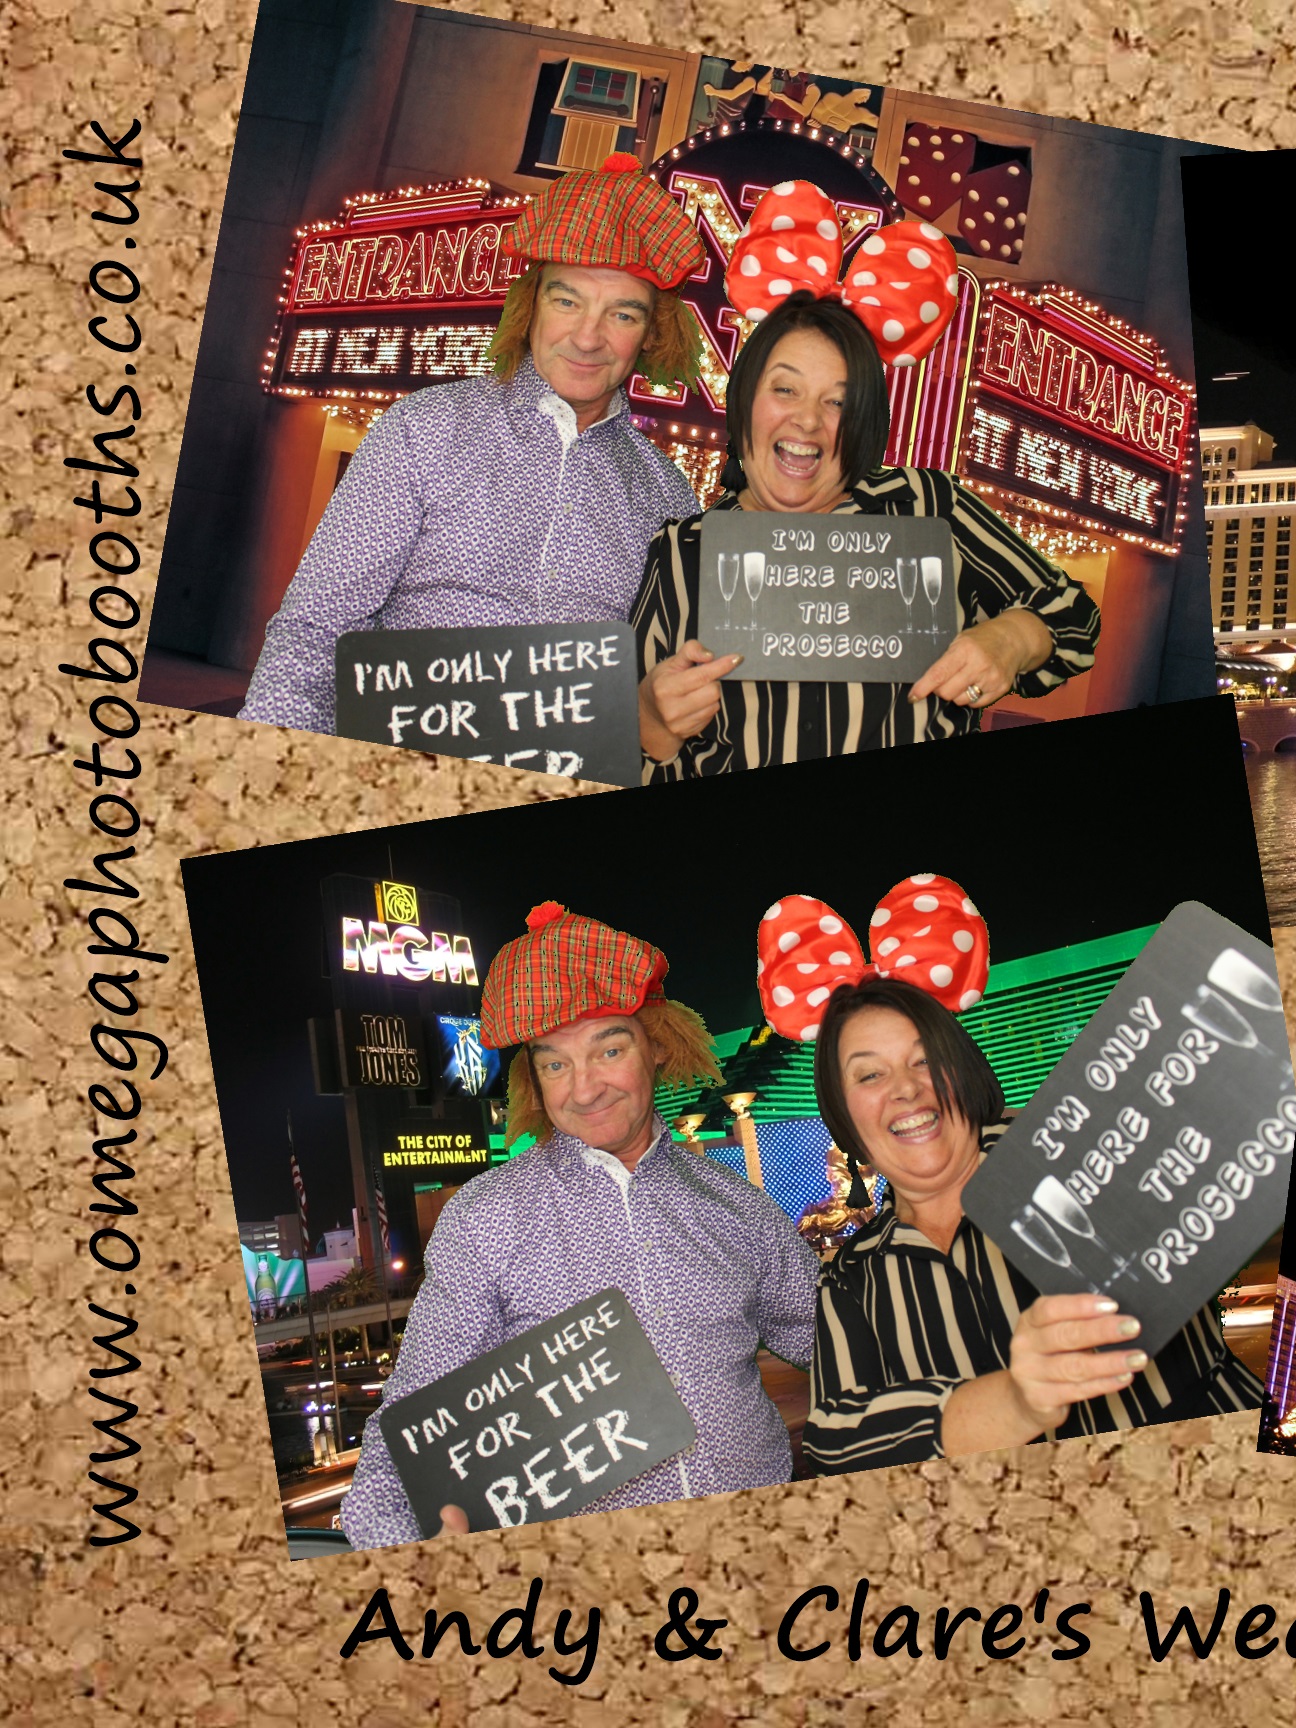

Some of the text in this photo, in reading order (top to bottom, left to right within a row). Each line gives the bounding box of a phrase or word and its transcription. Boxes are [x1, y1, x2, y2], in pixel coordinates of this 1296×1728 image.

[983, 303, 1185, 461] ENTRANCE
[772, 529, 892, 553] I'M ONLY
[765, 564, 897, 589] HERE FOR
[798, 601, 850, 624] THE
[354, 635, 620, 696] I'M ONLY HERE
[762, 633, 903, 659] PROSECCO
[387, 682, 595, 744] FOR THE
[342, 916, 480, 986] MGM
[360, 1014, 407, 1048] TOM
[360, 1051, 421, 1086] JONES
[1032, 995, 1162, 1161] I'M ONLY
[397, 1134, 472, 1149] THE CITY OF
[1064, 1028, 1220, 1206] HERE FOR
[383, 1149, 487, 1166] ENTERTAINMENT
[1138, 1126, 1211, 1203] THE
[401, 1301, 621, 1454] I'M ONLY HERE
[448, 1347, 621, 1480] FOR THE
[485, 1409, 649, 1528] BEER
